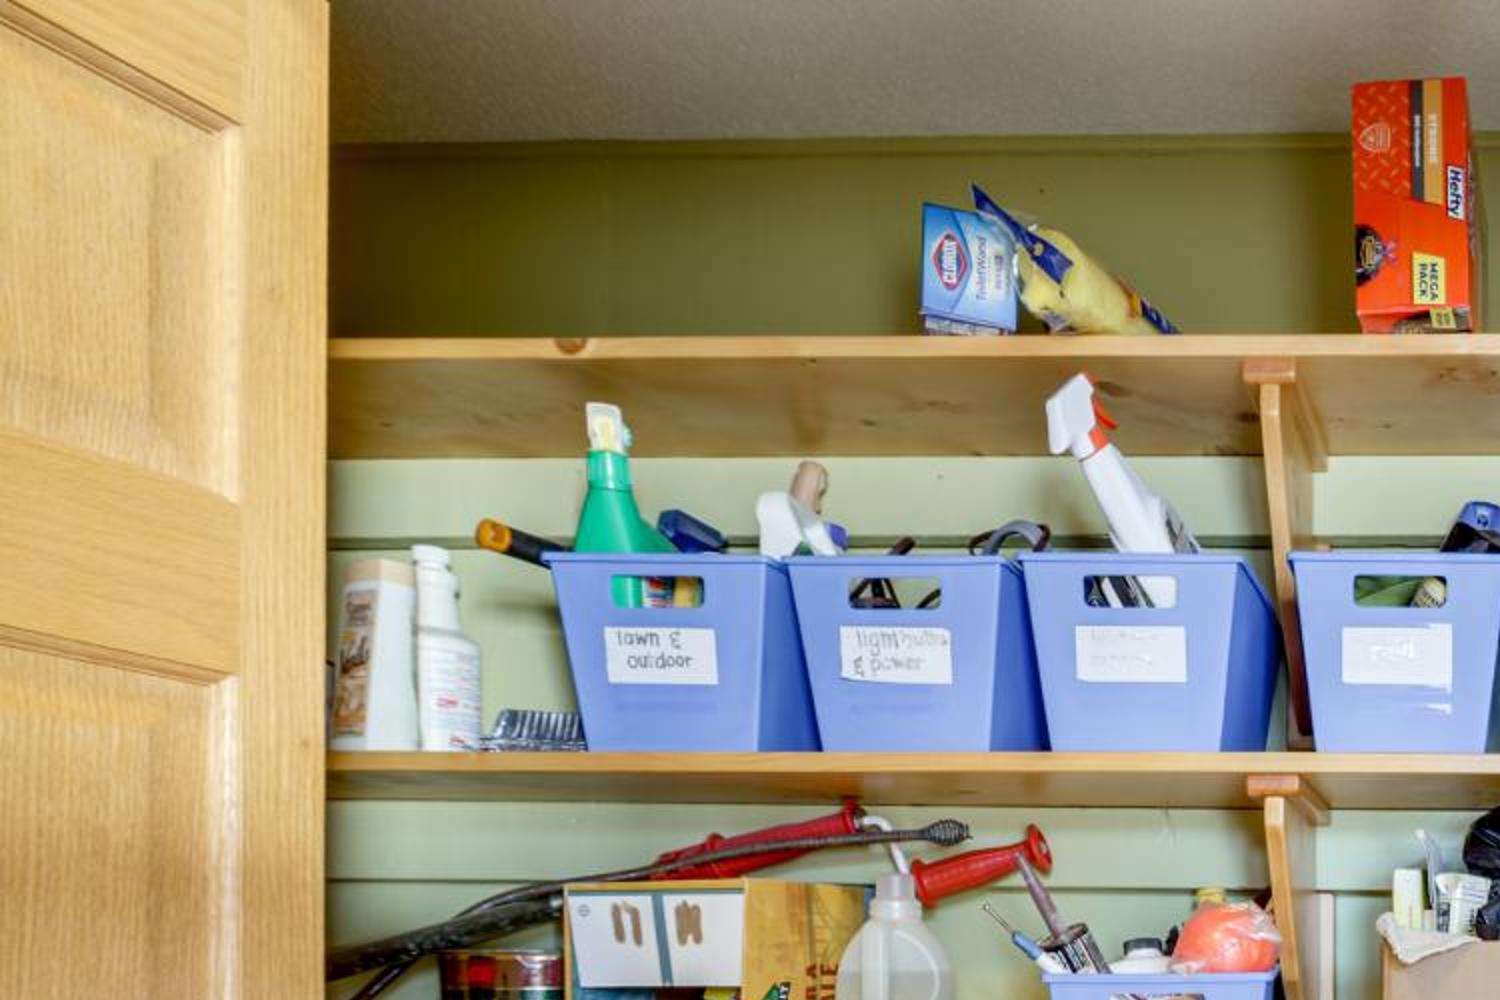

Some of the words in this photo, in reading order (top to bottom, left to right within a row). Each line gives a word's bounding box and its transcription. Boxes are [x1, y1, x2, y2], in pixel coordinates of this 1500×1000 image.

[1448, 168, 1464, 216] Hefty
[1418, 262, 1428, 298] PACK
[1429, 262, 1439, 301] MEGA
[616, 629, 661, 647] lawn
[626, 653, 692, 670] outdoor
